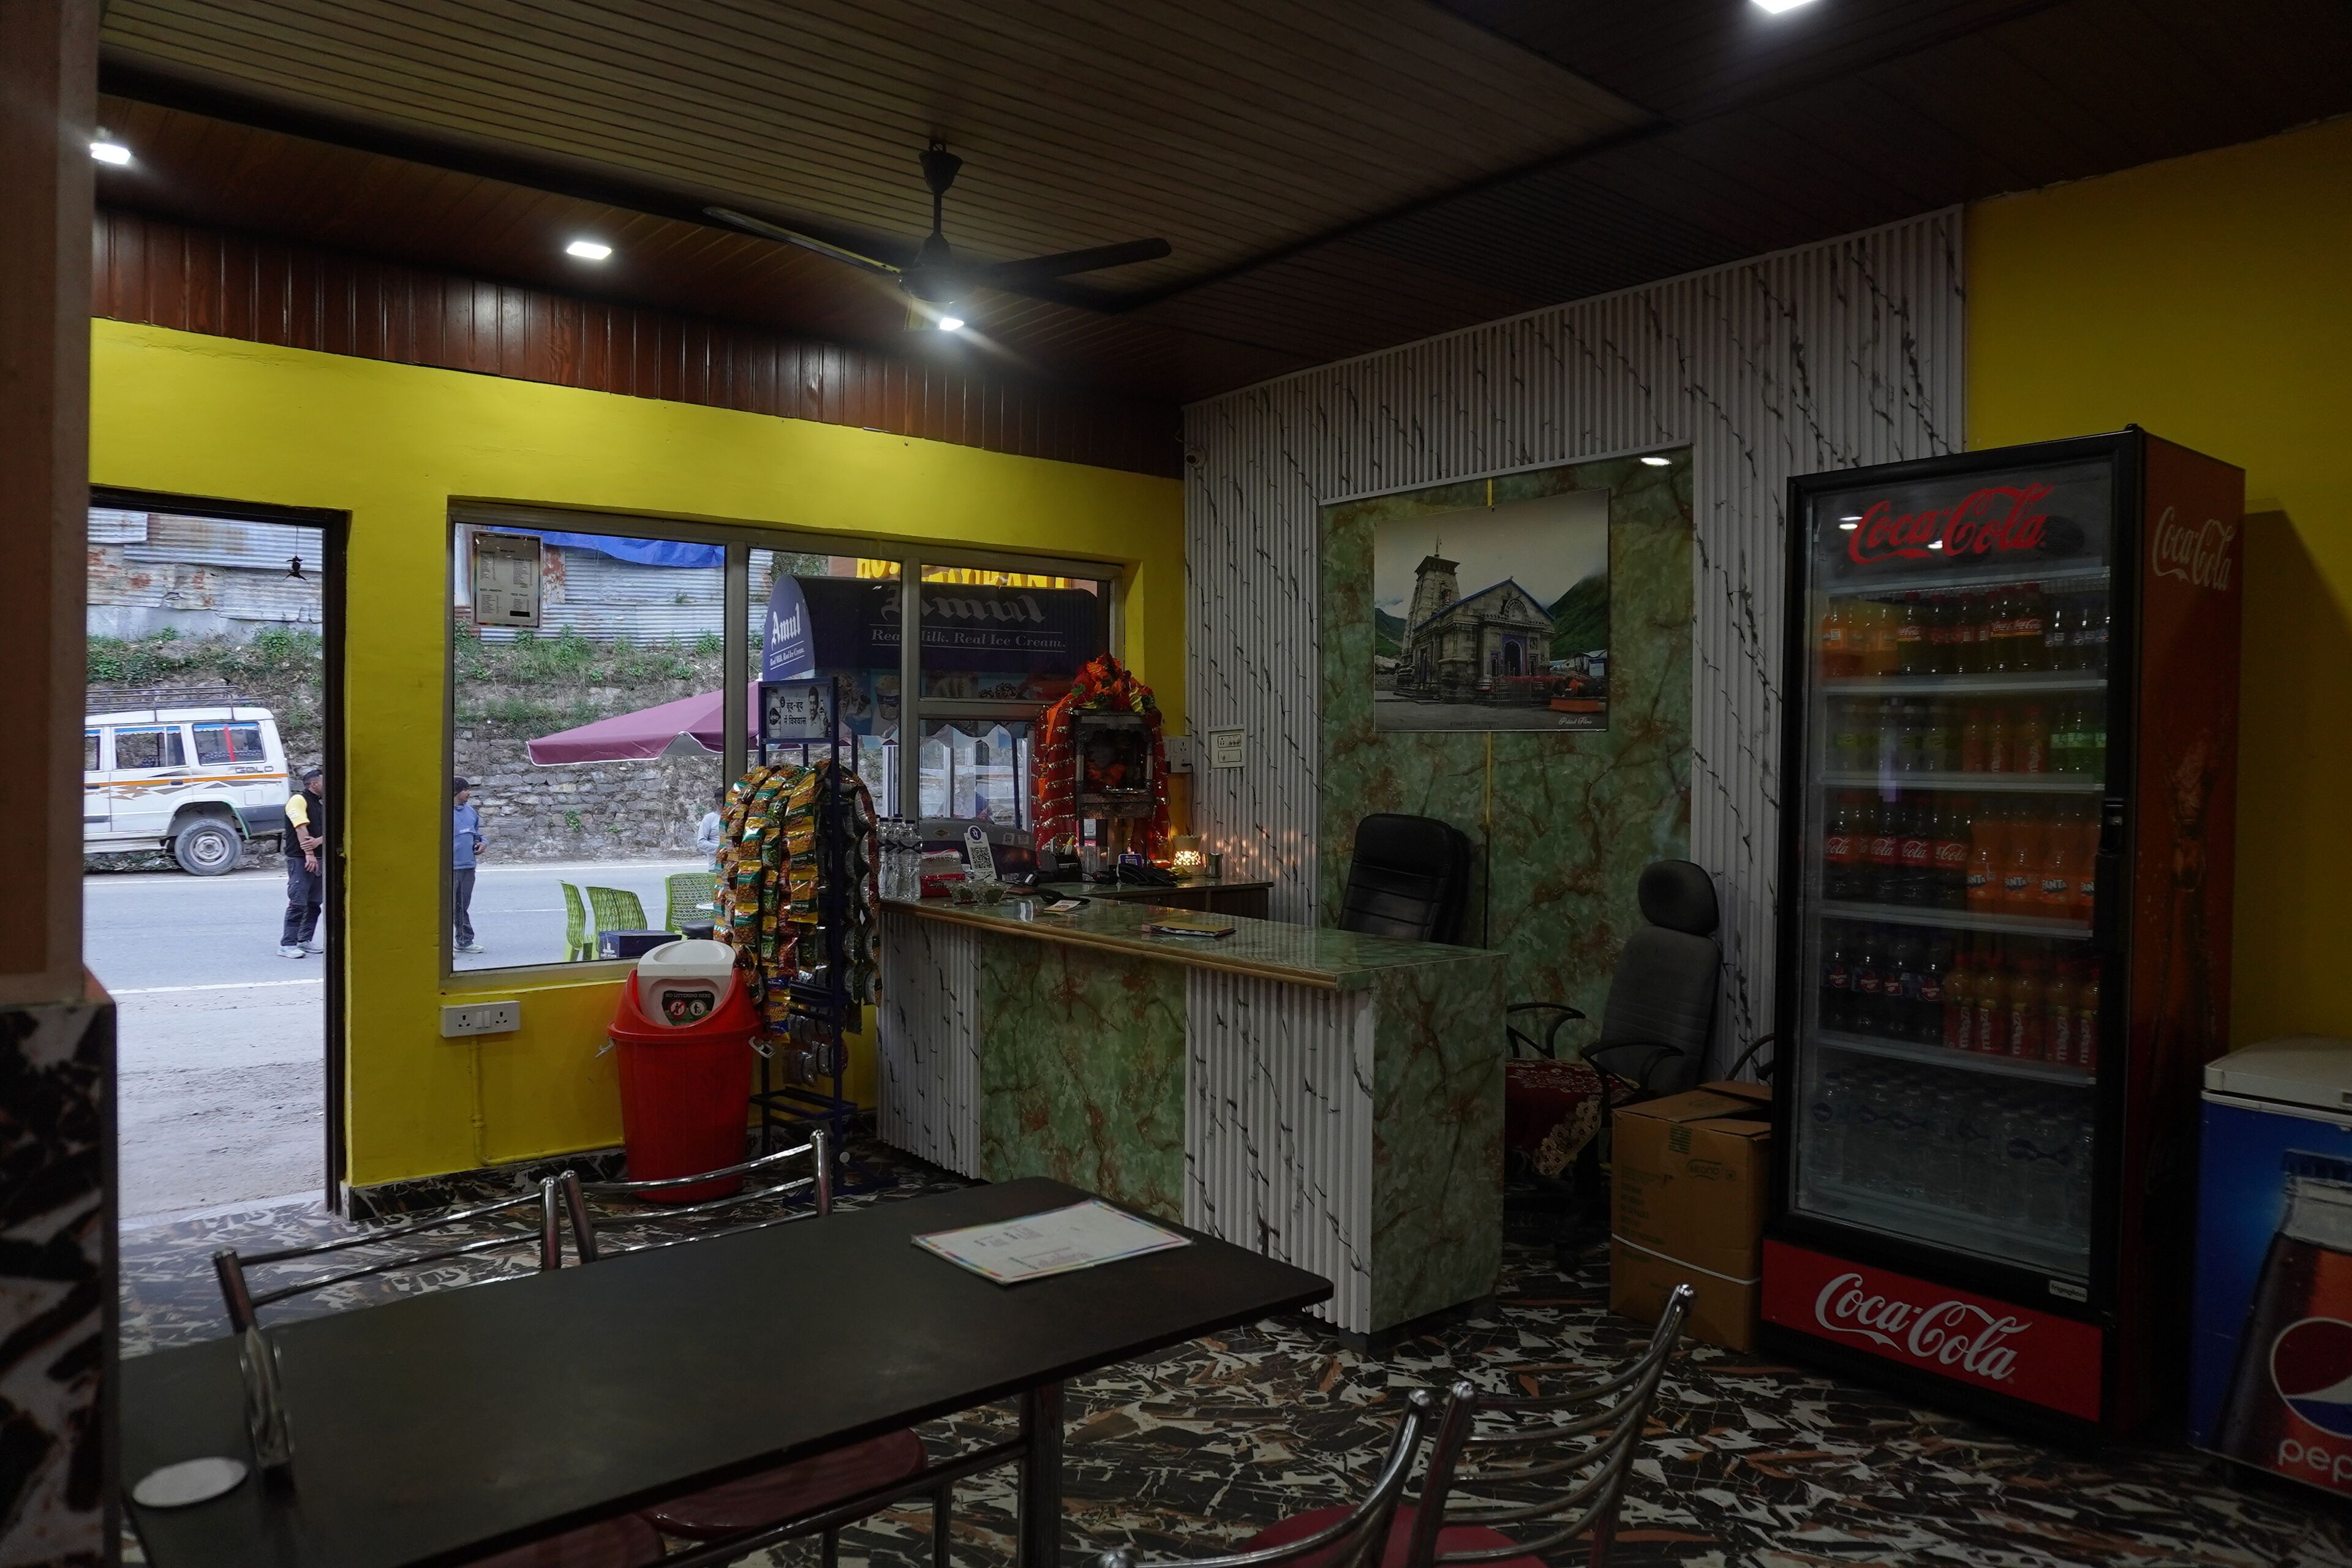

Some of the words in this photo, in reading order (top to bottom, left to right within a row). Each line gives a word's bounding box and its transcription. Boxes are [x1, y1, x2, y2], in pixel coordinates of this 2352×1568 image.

[1849, 482, 2056, 565] Coca-Cola
[2152, 505, 2236, 592] Coca-Cola
[771, 602, 801, 651] Amul
[872, 630, 901, 641] Rea
[953, 631, 986, 645] Real
[989, 633, 1011, 646] Ice
[1015, 635, 1066, 648] Cream.
[1814, 1273, 2034, 1382] Coca-Cola
